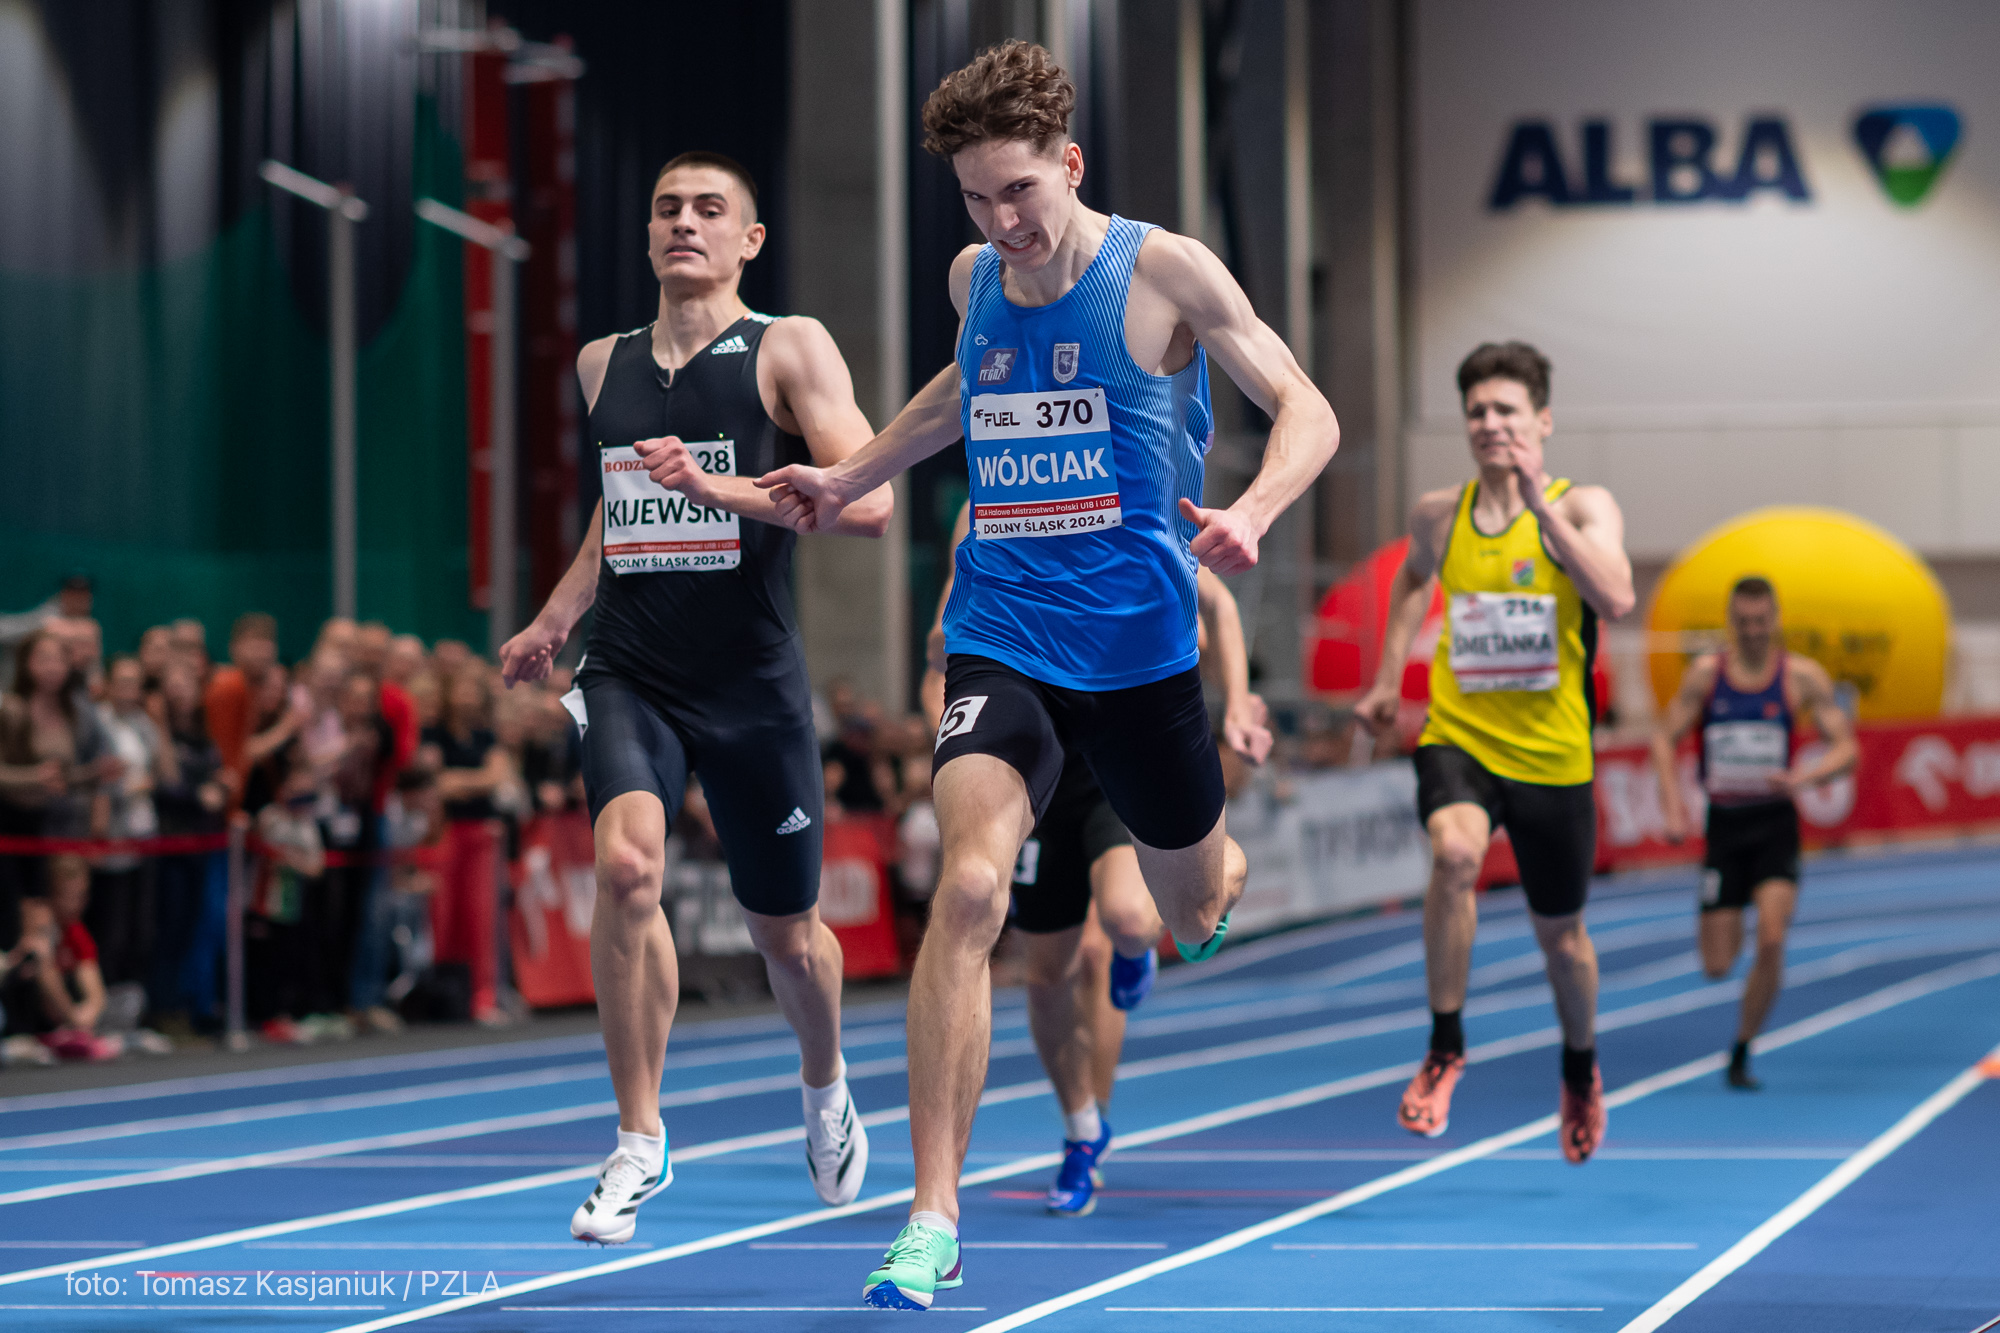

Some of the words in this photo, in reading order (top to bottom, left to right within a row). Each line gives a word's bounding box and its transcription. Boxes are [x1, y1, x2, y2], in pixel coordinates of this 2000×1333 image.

[1488, 117, 1814, 209] ALBA
[974, 409, 984, 419] 4F
[985, 411, 1021, 428] FUEL
[1036, 398, 1093, 429] 370
[604, 459, 646, 474] BODZ
[689, 449, 731, 474] 28
[977, 448, 1109, 488] WÓJCIAK
[988, 507, 1011, 516] Halowe
[1011, 506, 1055, 515] Mistrzostwa
[1056, 503, 1079, 513] Polski
[1080, 501, 1094, 510] U18
[1100, 498, 1116, 507] U20
[984, 522, 1021, 535] DOLNY
[1025, 519, 1066, 534] ŚLĄSK
[1069, 514, 1106, 529] 2024
[612, 557, 648, 569] DOLNY
[651, 555, 690, 568] ŚLĄSK
[693, 555, 726, 566] 2024
[941, 698, 972, 739] 5
